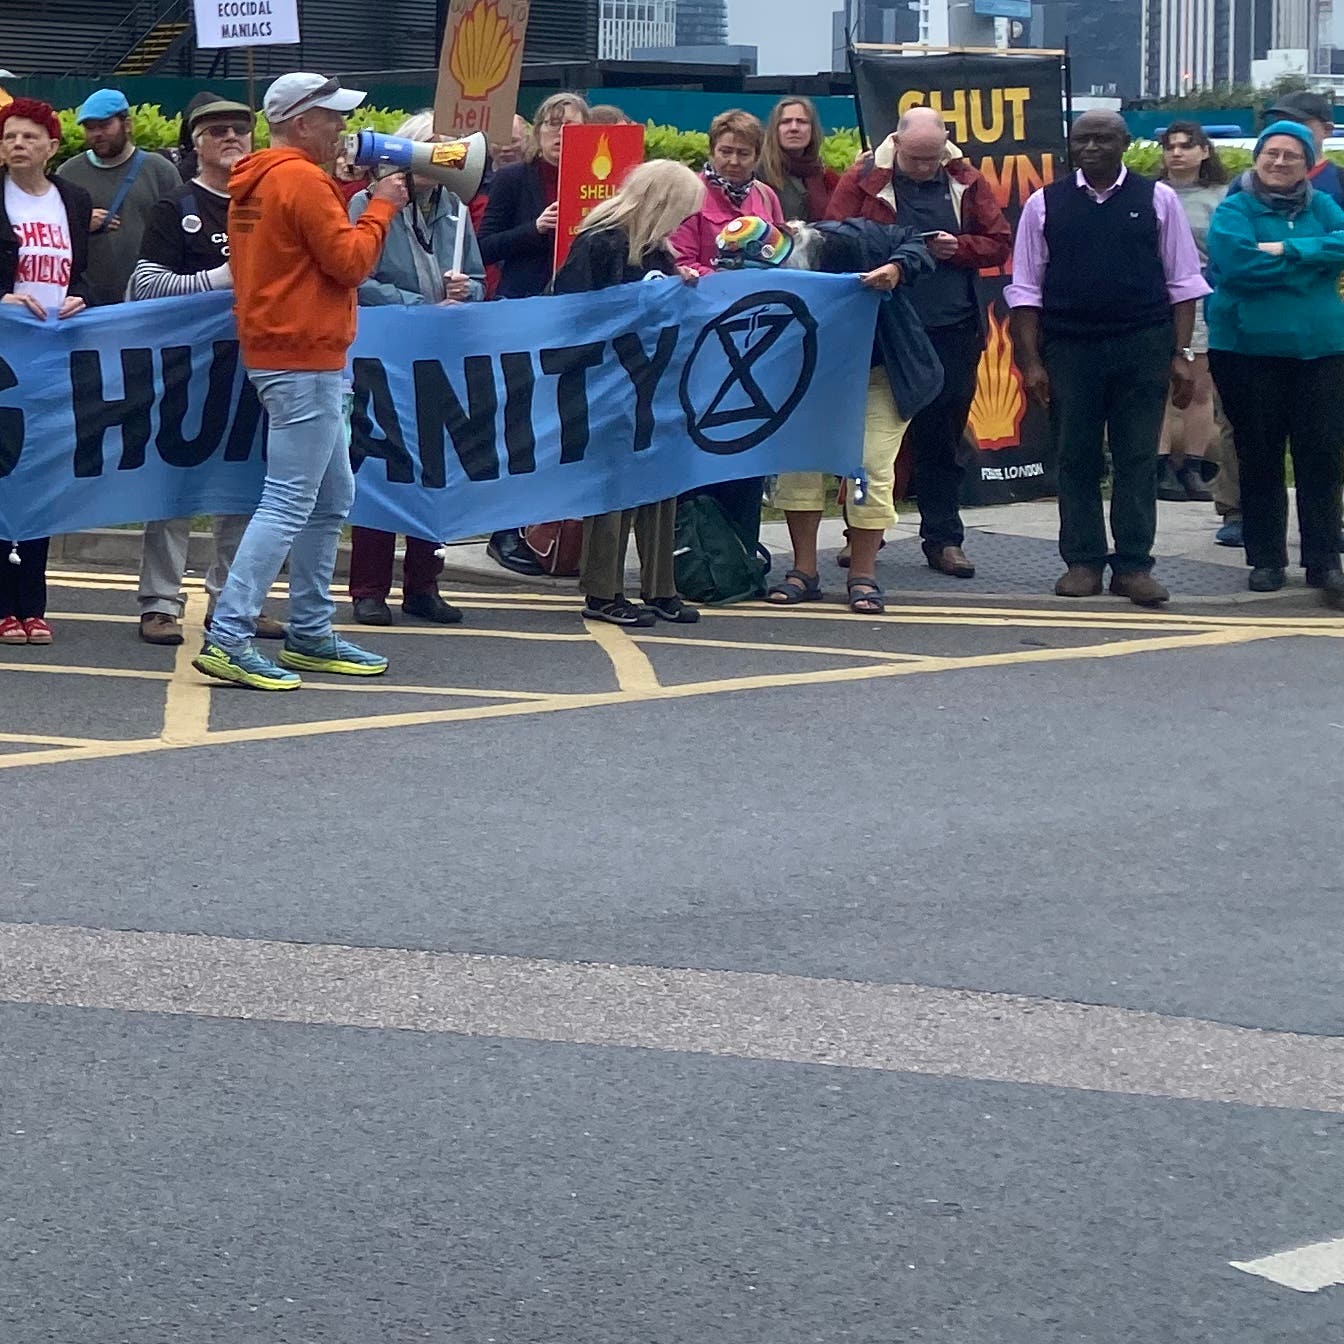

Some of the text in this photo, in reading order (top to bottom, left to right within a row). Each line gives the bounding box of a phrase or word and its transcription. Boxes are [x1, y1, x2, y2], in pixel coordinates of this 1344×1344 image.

[218, 1, 273, 17] ECOCIDAL
[221, 21, 273, 39] MANIACS
[453, 103, 491, 132] hell
[963, 153, 1054, 208] WN
[11, 222, 69, 249] SHELL
[16, 254, 72, 287] KILLS
